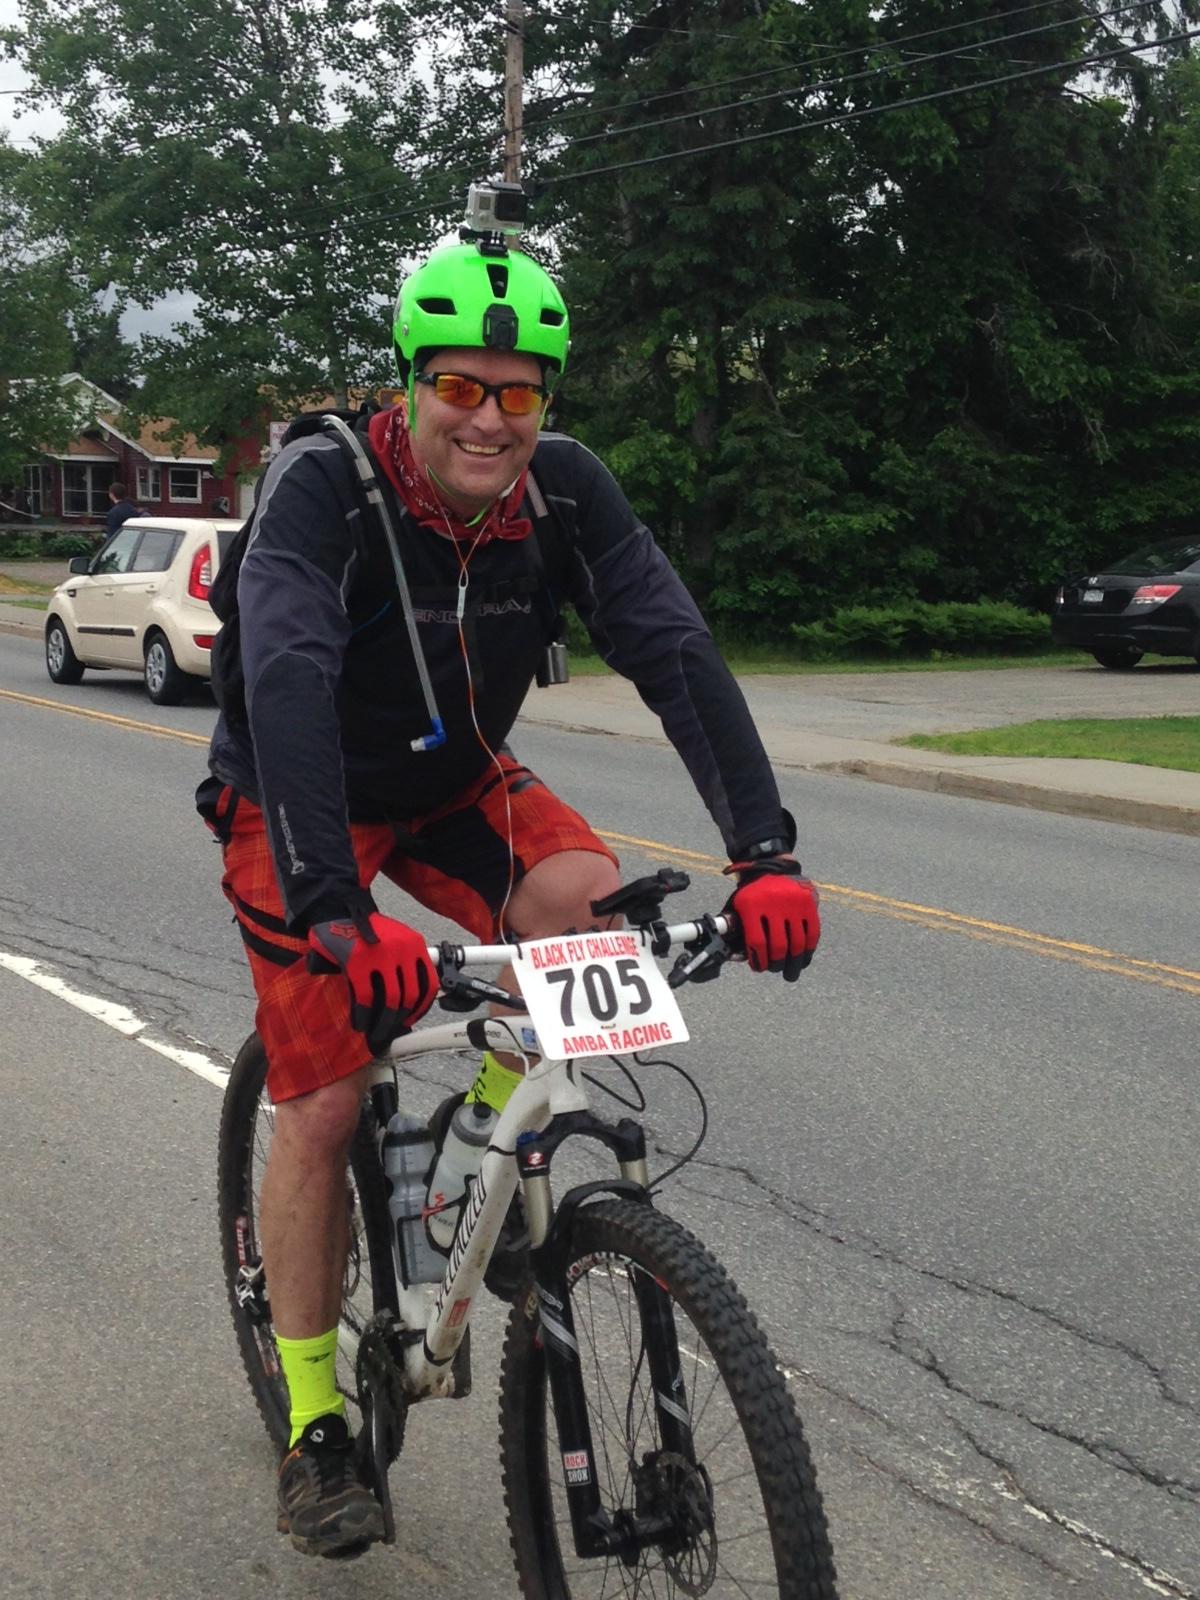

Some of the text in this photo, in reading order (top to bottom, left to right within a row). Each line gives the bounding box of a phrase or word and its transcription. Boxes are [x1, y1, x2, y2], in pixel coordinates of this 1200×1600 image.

[531, 936, 640, 969] BLACK FLY CHALLENGE
[545, 959, 652, 1027] 705
[562, 1022, 673, 1054] AMBA RACING
